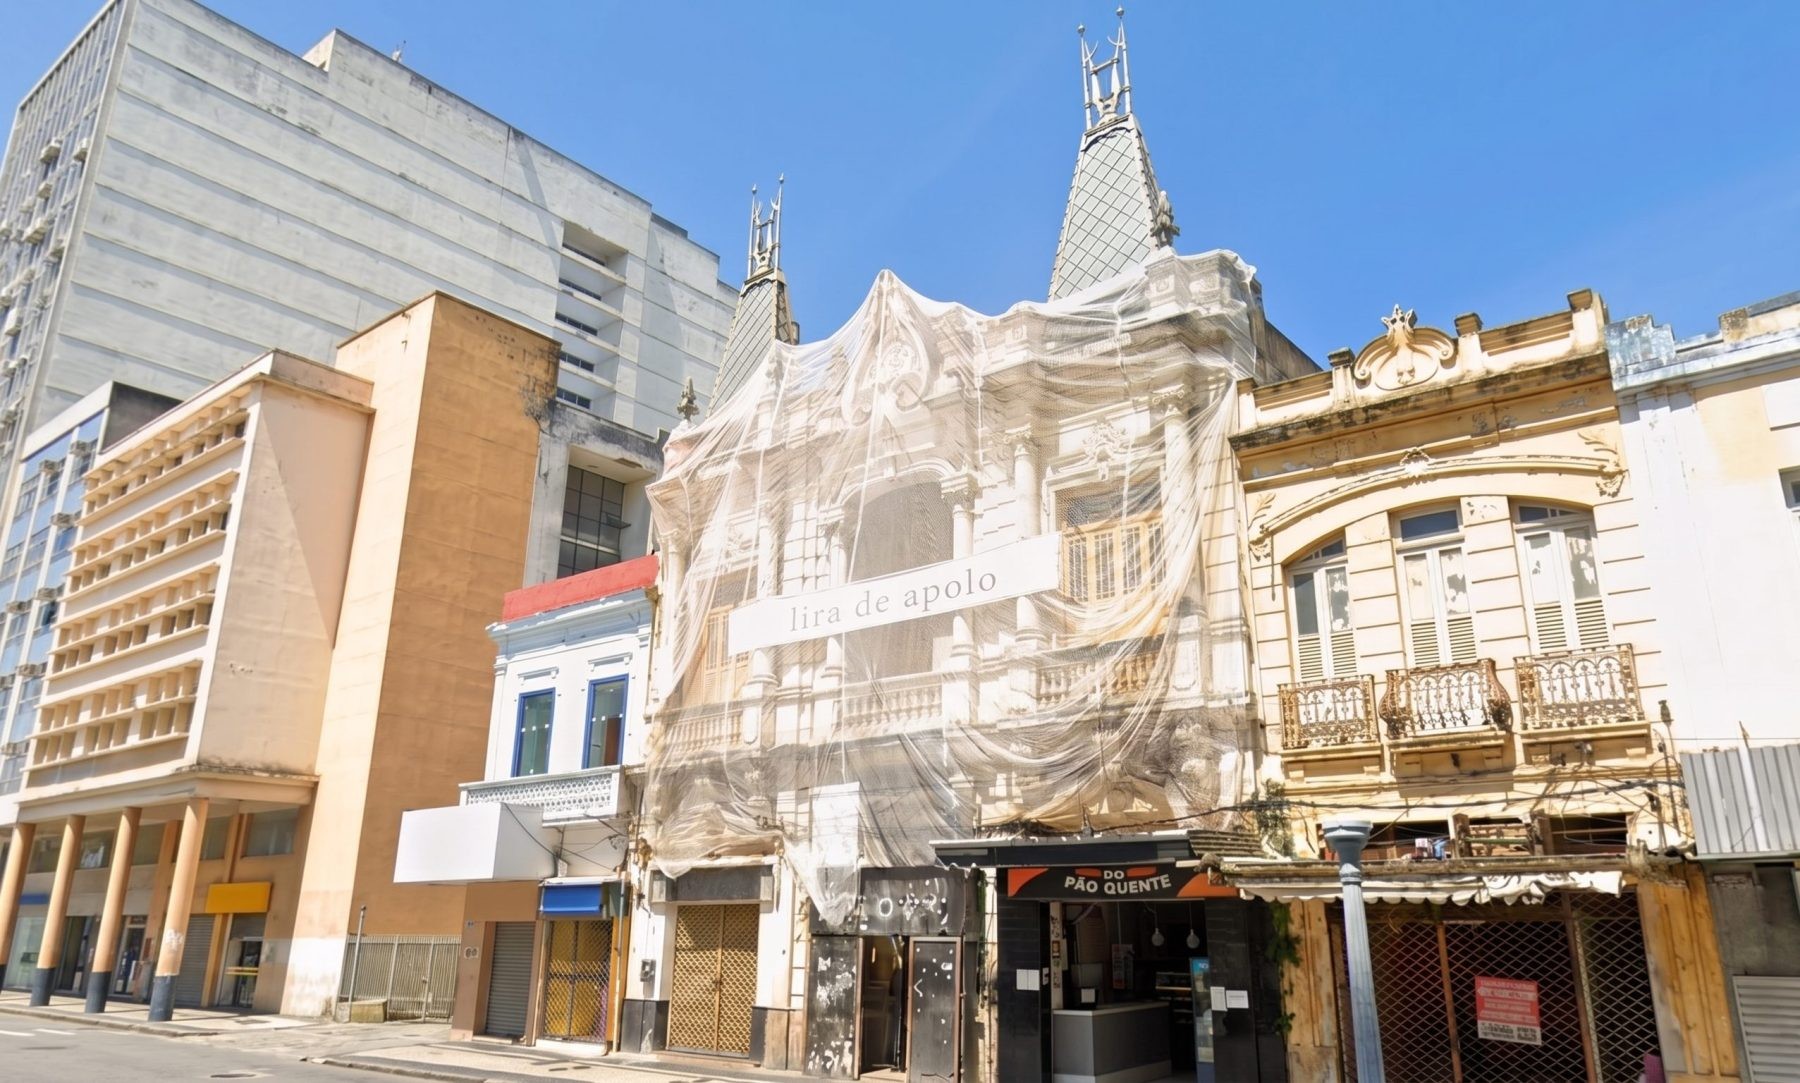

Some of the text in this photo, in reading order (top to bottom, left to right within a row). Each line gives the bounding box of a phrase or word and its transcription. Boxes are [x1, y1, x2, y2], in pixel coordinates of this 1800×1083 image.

[790, 568, 997, 632] lira de apolo
[1064, 874, 1172, 895] PÃO QUENTE
[1103, 870, 1125, 880] DO
